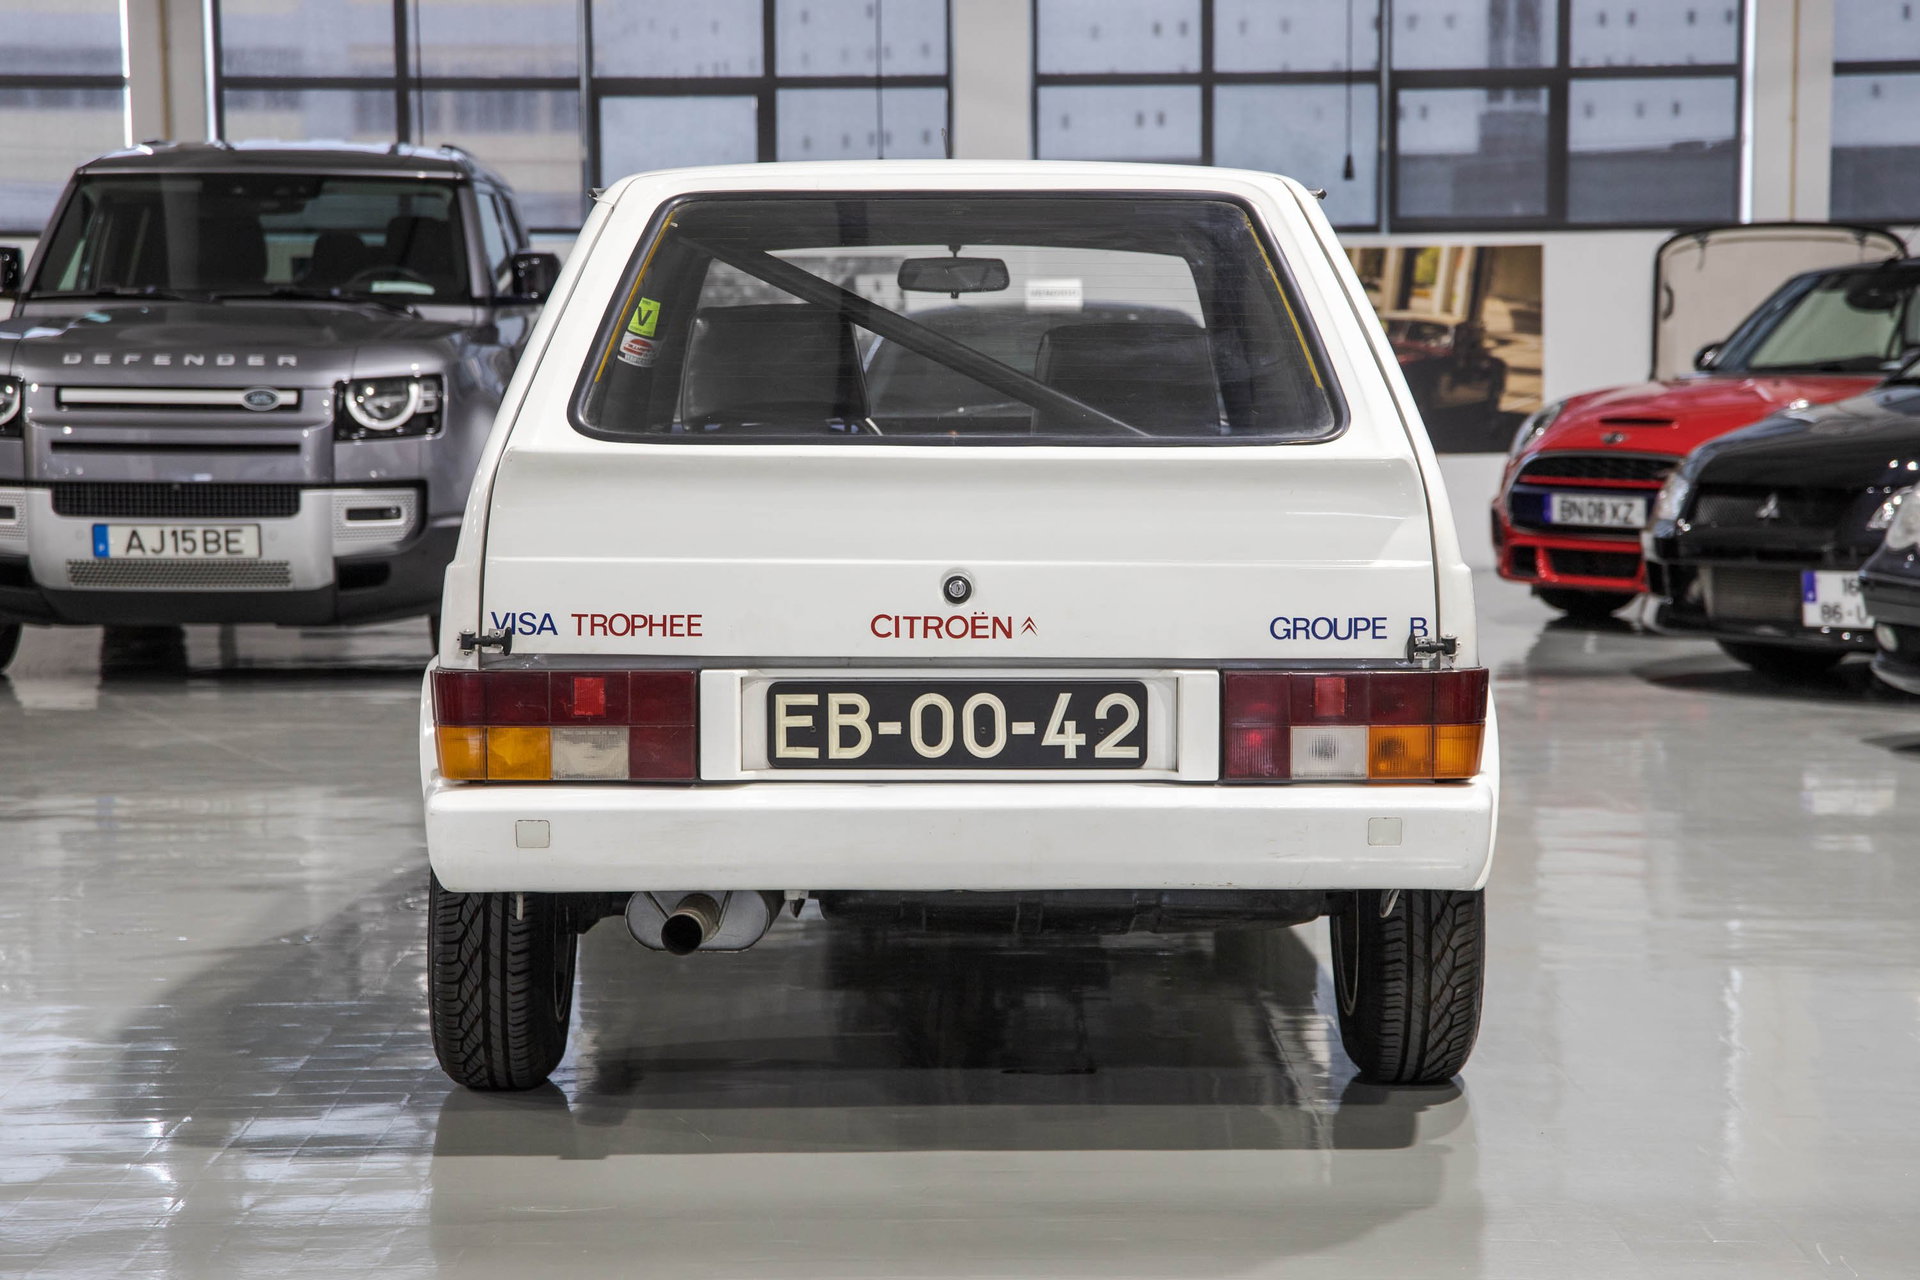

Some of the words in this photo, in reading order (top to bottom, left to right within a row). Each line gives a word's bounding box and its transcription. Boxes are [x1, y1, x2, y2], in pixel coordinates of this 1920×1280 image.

[637, 306, 654, 326] V
[62, 352, 298, 367] DEFENDER
[490, 611, 559, 637] VISA
[571, 613, 703, 638] TROPHEE
[870, 611, 1013, 640] CITROËN
[1269, 616, 1388, 641] GROUPE
[1409, 616, 1429, 639] B
[774, 692, 1141, 760] EB-00-42
